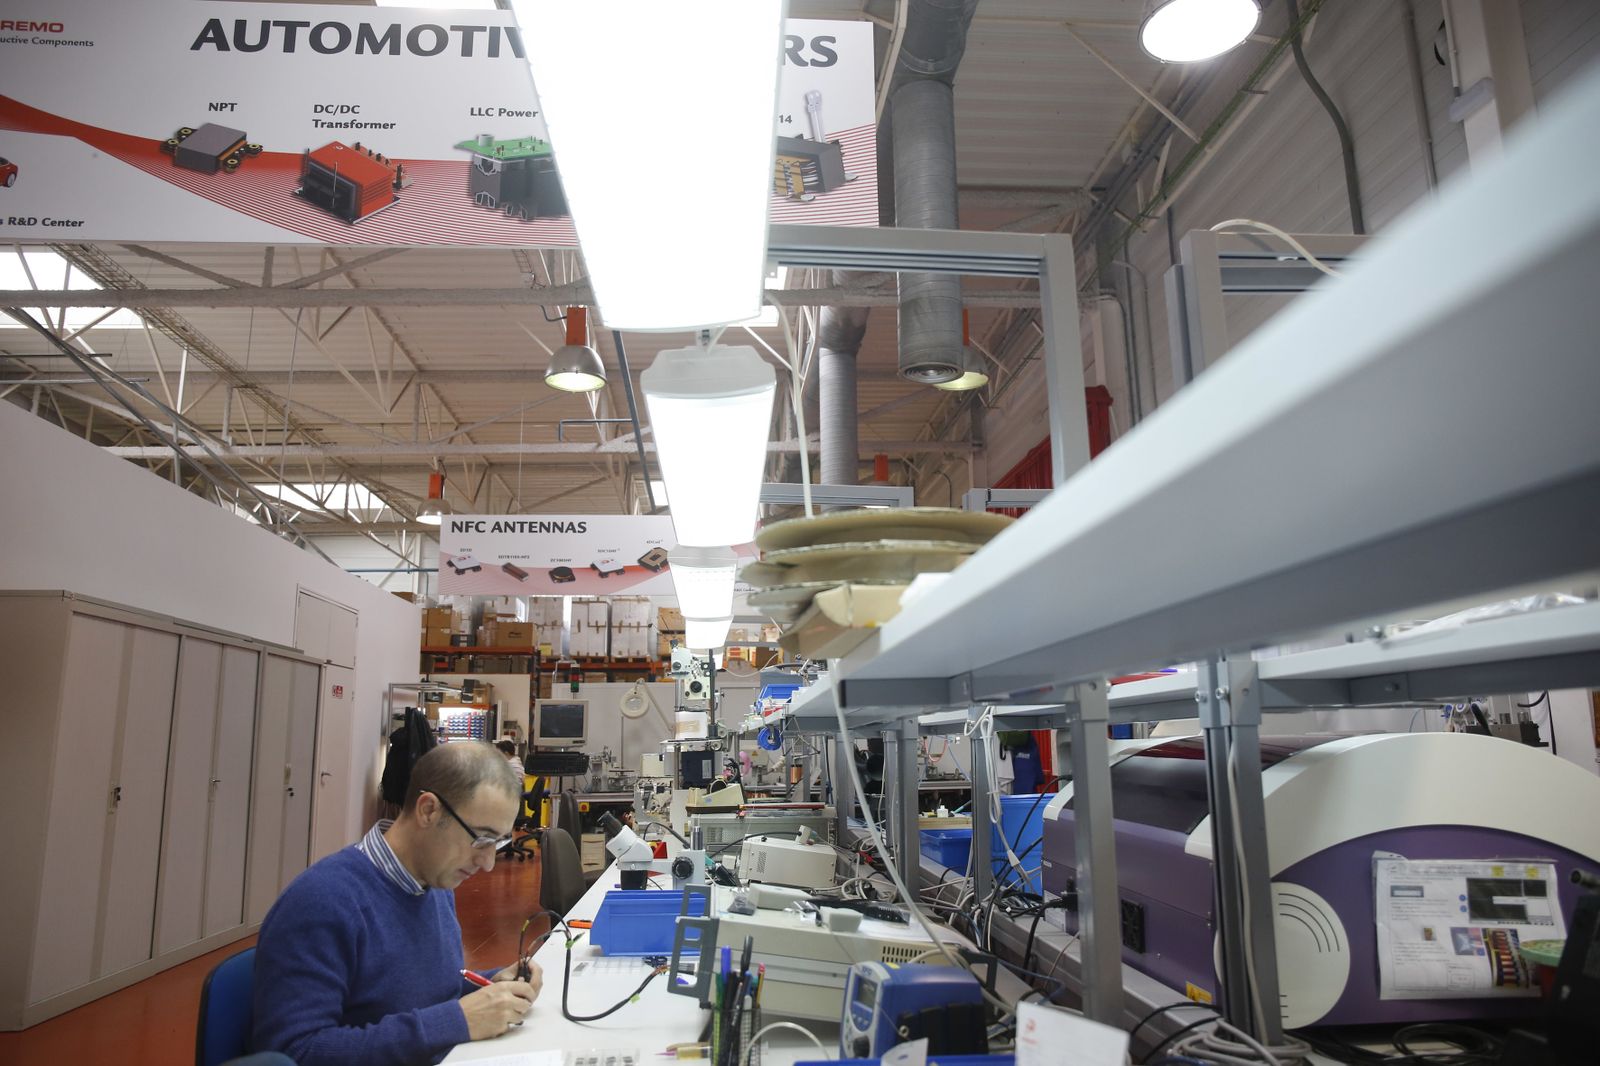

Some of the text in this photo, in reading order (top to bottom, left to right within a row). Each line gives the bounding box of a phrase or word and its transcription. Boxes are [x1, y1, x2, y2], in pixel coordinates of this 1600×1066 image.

[31, 36, 94, 48] Components
[208, 102, 238, 112] NPT
[313, 104, 361, 115] DC/DC
[470, 107, 539, 118] LLC Power
[312, 119, 396, 130] Transformer
[778, 114, 793, 124] 14
[8, 216, 38, 226] R&D
[41, 217, 84, 227] Center
[451, 521, 587, 534] NFC ANTENNAS
